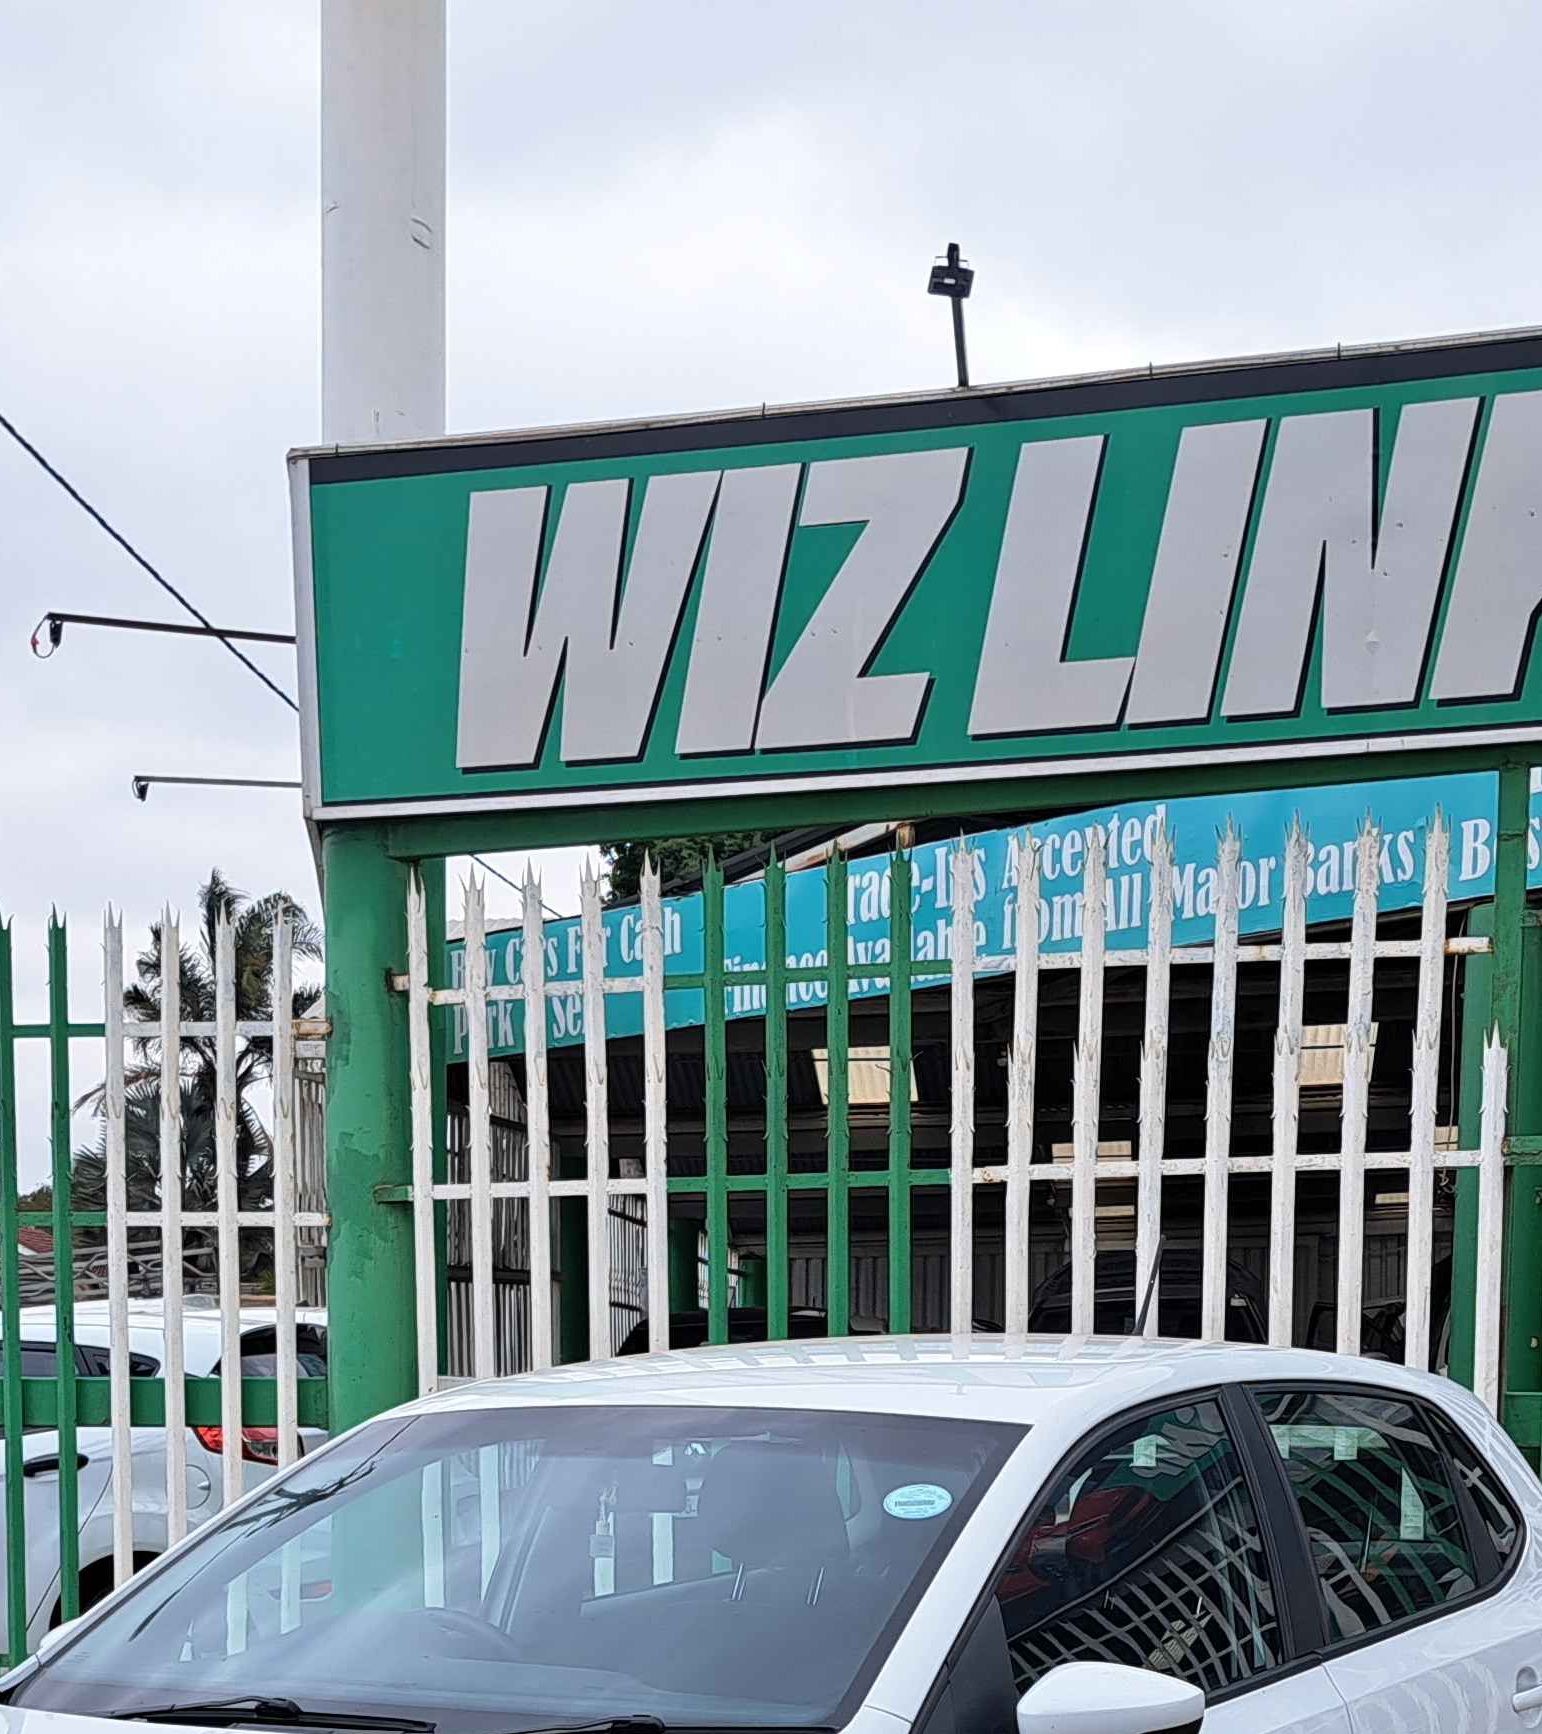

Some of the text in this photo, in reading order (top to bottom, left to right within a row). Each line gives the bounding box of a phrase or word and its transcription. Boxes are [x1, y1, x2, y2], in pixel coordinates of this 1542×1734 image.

[457, 446, 972, 773] WIZ
[567, 924, 612, 974] Fr
[619, 906, 682, 965] Cah
[1002, 892, 1087, 950] fom
[1170, 856, 1276, 920] Maor
[453, 1000, 515, 1055] Prk
